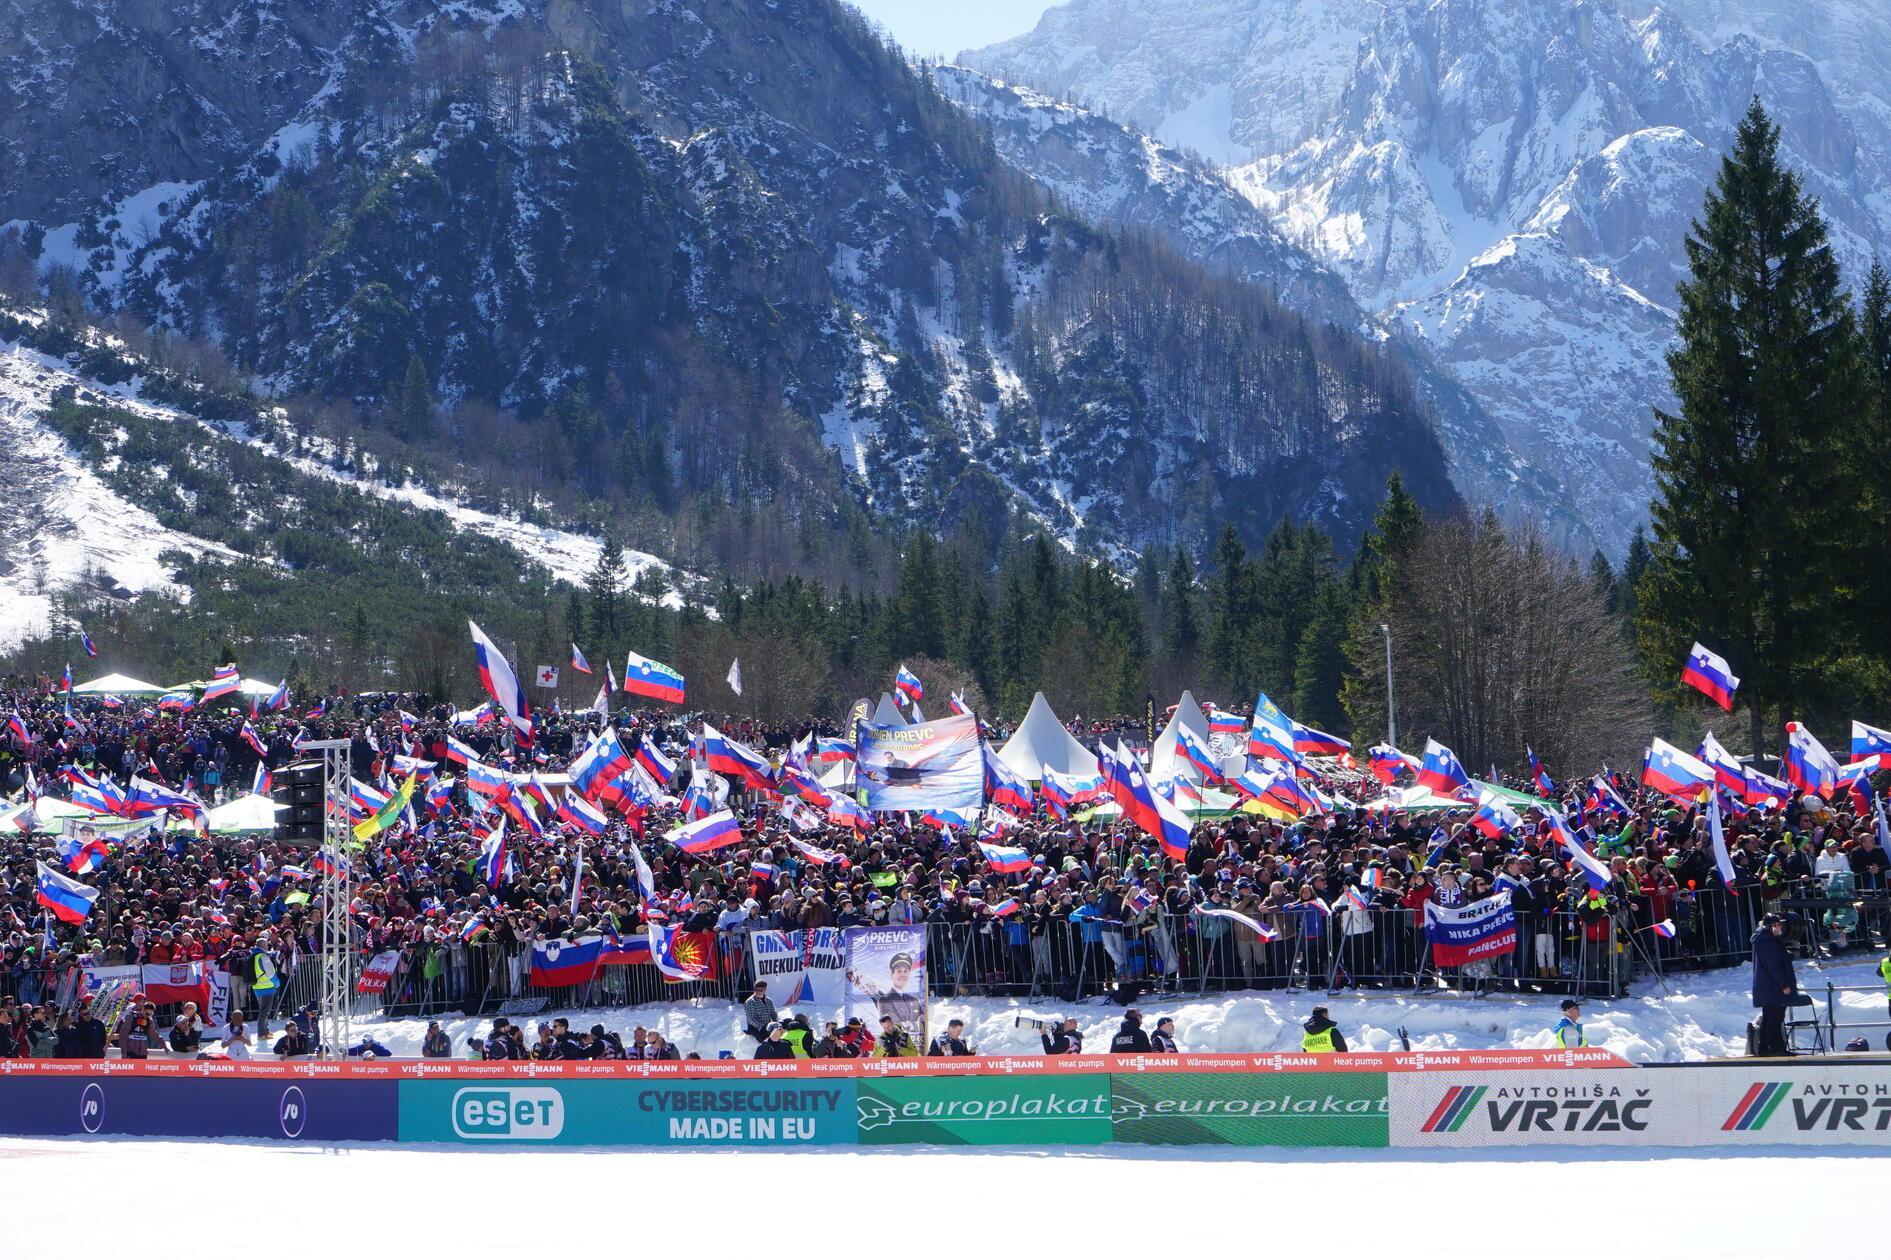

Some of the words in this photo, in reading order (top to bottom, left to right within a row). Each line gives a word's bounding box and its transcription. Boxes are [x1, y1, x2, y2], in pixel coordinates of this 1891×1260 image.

[895, 728, 934, 742] PREVC
[869, 930, 909, 944] PREVC
[1448, 928, 1481, 939] NIKA
[987, 1057, 1044, 1073] VIESSMANN
[1078, 1060, 1105, 1069] pumps
[1116, 1055, 1178, 1071] VIESSMANN
[1186, 1058, 1246, 1068] Wärmepumpen
[1253, 1054, 1317, 1070] VIESSMANN
[1333, 1057, 1353, 1065] Heat
[1354, 1058, 1383, 1067] pumps
[1395, 1053, 1460, 1070] VIESSMANN
[1469, 1056, 1534, 1065] Wärmepumpen
[1542, 1050, 1611, 1066] VIESSMANN
[41, 1063, 83, 1074] Wärmepumpen
[90, 1060, 134, 1074] VIESSMANN
[145, 1063, 159, 1071] Heat
[160, 1064, 179, 1075] pumps
[188, 1062, 235, 1075] VIESSMANN
[240, 1065, 285, 1075] Wärmepumpen
[293, 1062, 340, 1076] VIESSMANN
[367, 1066, 389, 1075] pumps
[401, 1062, 451, 1077] VIESSMANN
[457, 1065, 505, 1075] Wärmepumpen
[512, 1062, 563, 1076] VIESSMANN
[575, 1065, 591, 1073] Heat
[592, 1066, 615, 1074] pumps
[625, 1062, 678, 1076] VIESSMANN
[684, 1064, 736, 1074] Wärmepumpen
[742, 1061, 797, 1076] VIESSMANN
[811, 1063, 828, 1071] Heat
[829, 1064, 853, 1073] pumps
[862, 1059, 919, 1074] VIESSMANN
[926, 1061, 981, 1071] Wärmepumpen
[1497, 1083, 1621, 1098] AVTOHIŠA
[1803, 1084, 1887, 1096] AVTOH
[638, 1090, 842, 1112] CYBERSECURITY
[901, 1093, 1109, 1120] europlakat
[1154, 1095, 1389, 1117] europlakat
[1487, 1088, 1654, 1131] VRTAČ
[1792, 1098, 1891, 1130] VRT
[669, 1117, 743, 1139] MADE
[750, 1117, 775, 1139] IN
[782, 1117, 816, 1139] EU
